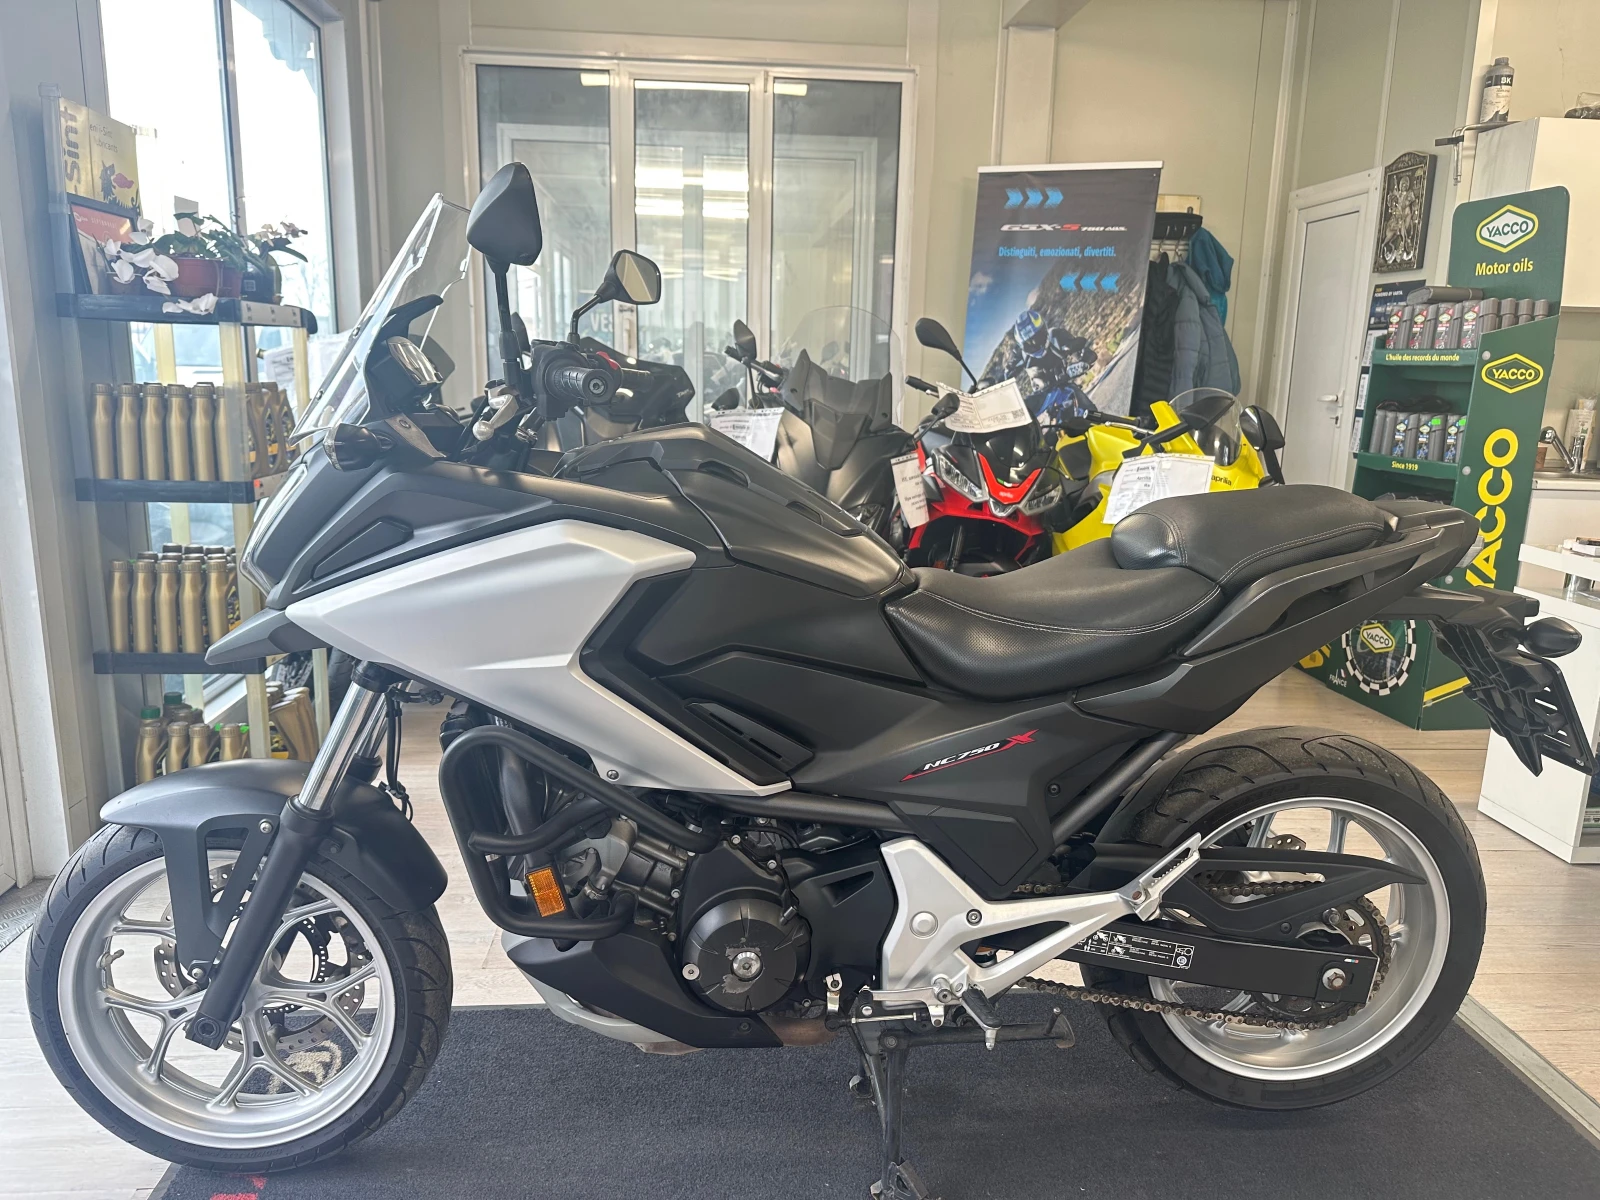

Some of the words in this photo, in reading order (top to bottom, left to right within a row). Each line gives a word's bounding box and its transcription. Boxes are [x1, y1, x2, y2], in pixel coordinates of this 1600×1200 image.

[1486, 220, 1528, 238] YACCO
[998, 246, 1038, 259] Distinguiti,
[1040, 246, 1082, 258] emozionati,
[1084, 246, 1116, 257] divertiti.
[1476, 262, 1510, 276] Motor
[1512, 258, 1534, 272] oils
[1386, 353, 1402, 361] L'huile
[1402, 353, 1411, 361] des
[1412, 353, 1431, 361] records
[1432, 353, 1440, 361] du
[1492, 368, 1535, 380] YACCO
[1392, 460, 1404, 469] Since
[1406, 462, 1418, 470] 1919
[1211, 474, 1232, 486] aprilia
[1366, 631, 1390, 646] YACCO
[1329, 670, 1348, 688] FRANCE
